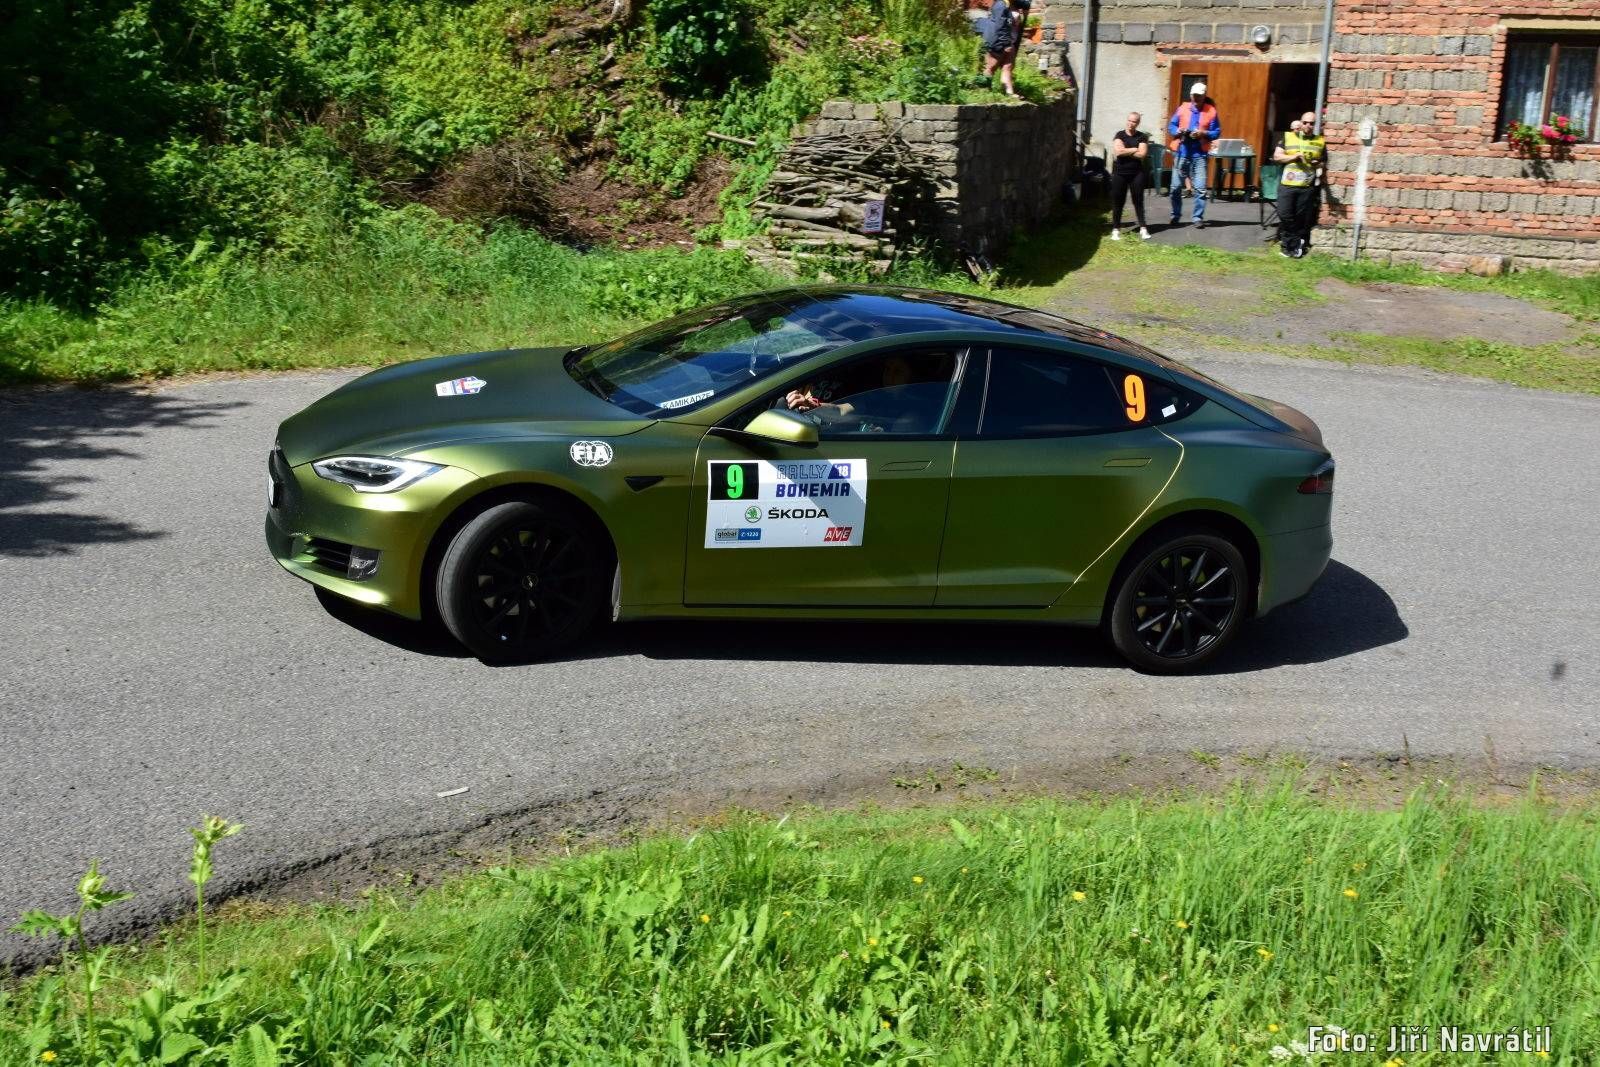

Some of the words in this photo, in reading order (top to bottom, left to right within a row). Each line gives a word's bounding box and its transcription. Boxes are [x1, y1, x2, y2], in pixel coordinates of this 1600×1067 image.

[663, 392, 711, 408] KAMIKADZE
[1124, 374, 1146, 422] 9
[777, 464, 828, 479] RALLY
[727, 464, 744, 499] 9
[776, 482, 851, 497] BOHEMIA
[768, 507, 829, 519] ŠKODA
[825, 529, 850, 539] AVE
